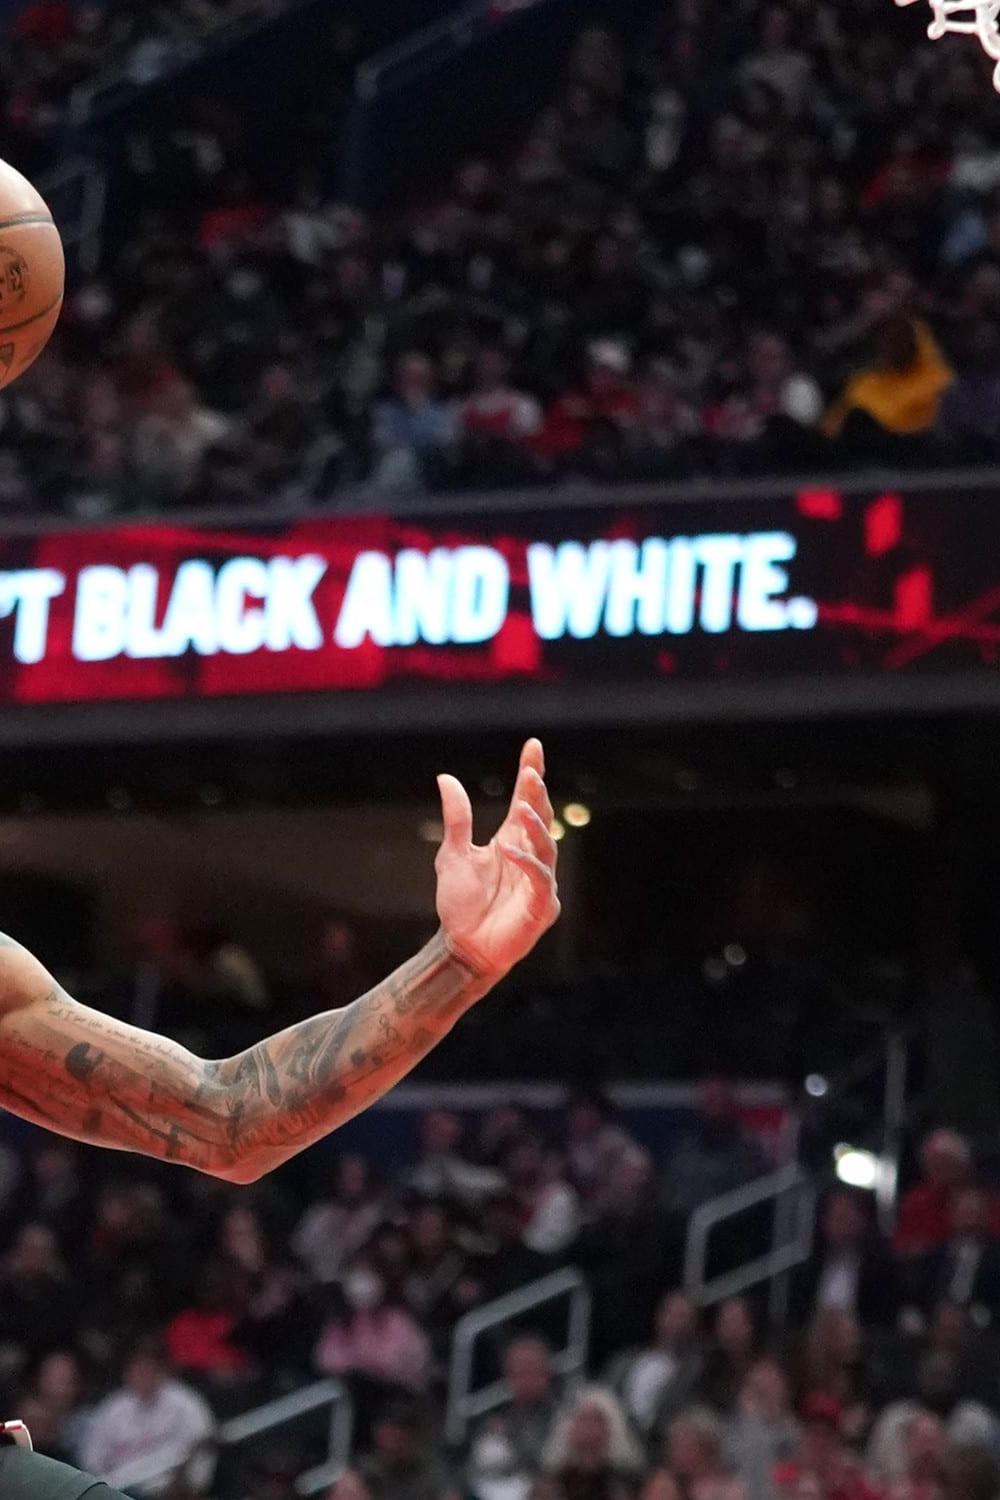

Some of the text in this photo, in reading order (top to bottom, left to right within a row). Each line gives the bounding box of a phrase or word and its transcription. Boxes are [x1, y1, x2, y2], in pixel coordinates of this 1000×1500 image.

[72, 552, 328, 662] BLACK
[333, 545, 509, 650] AND
[526, 530, 818, 642] WHITE.
